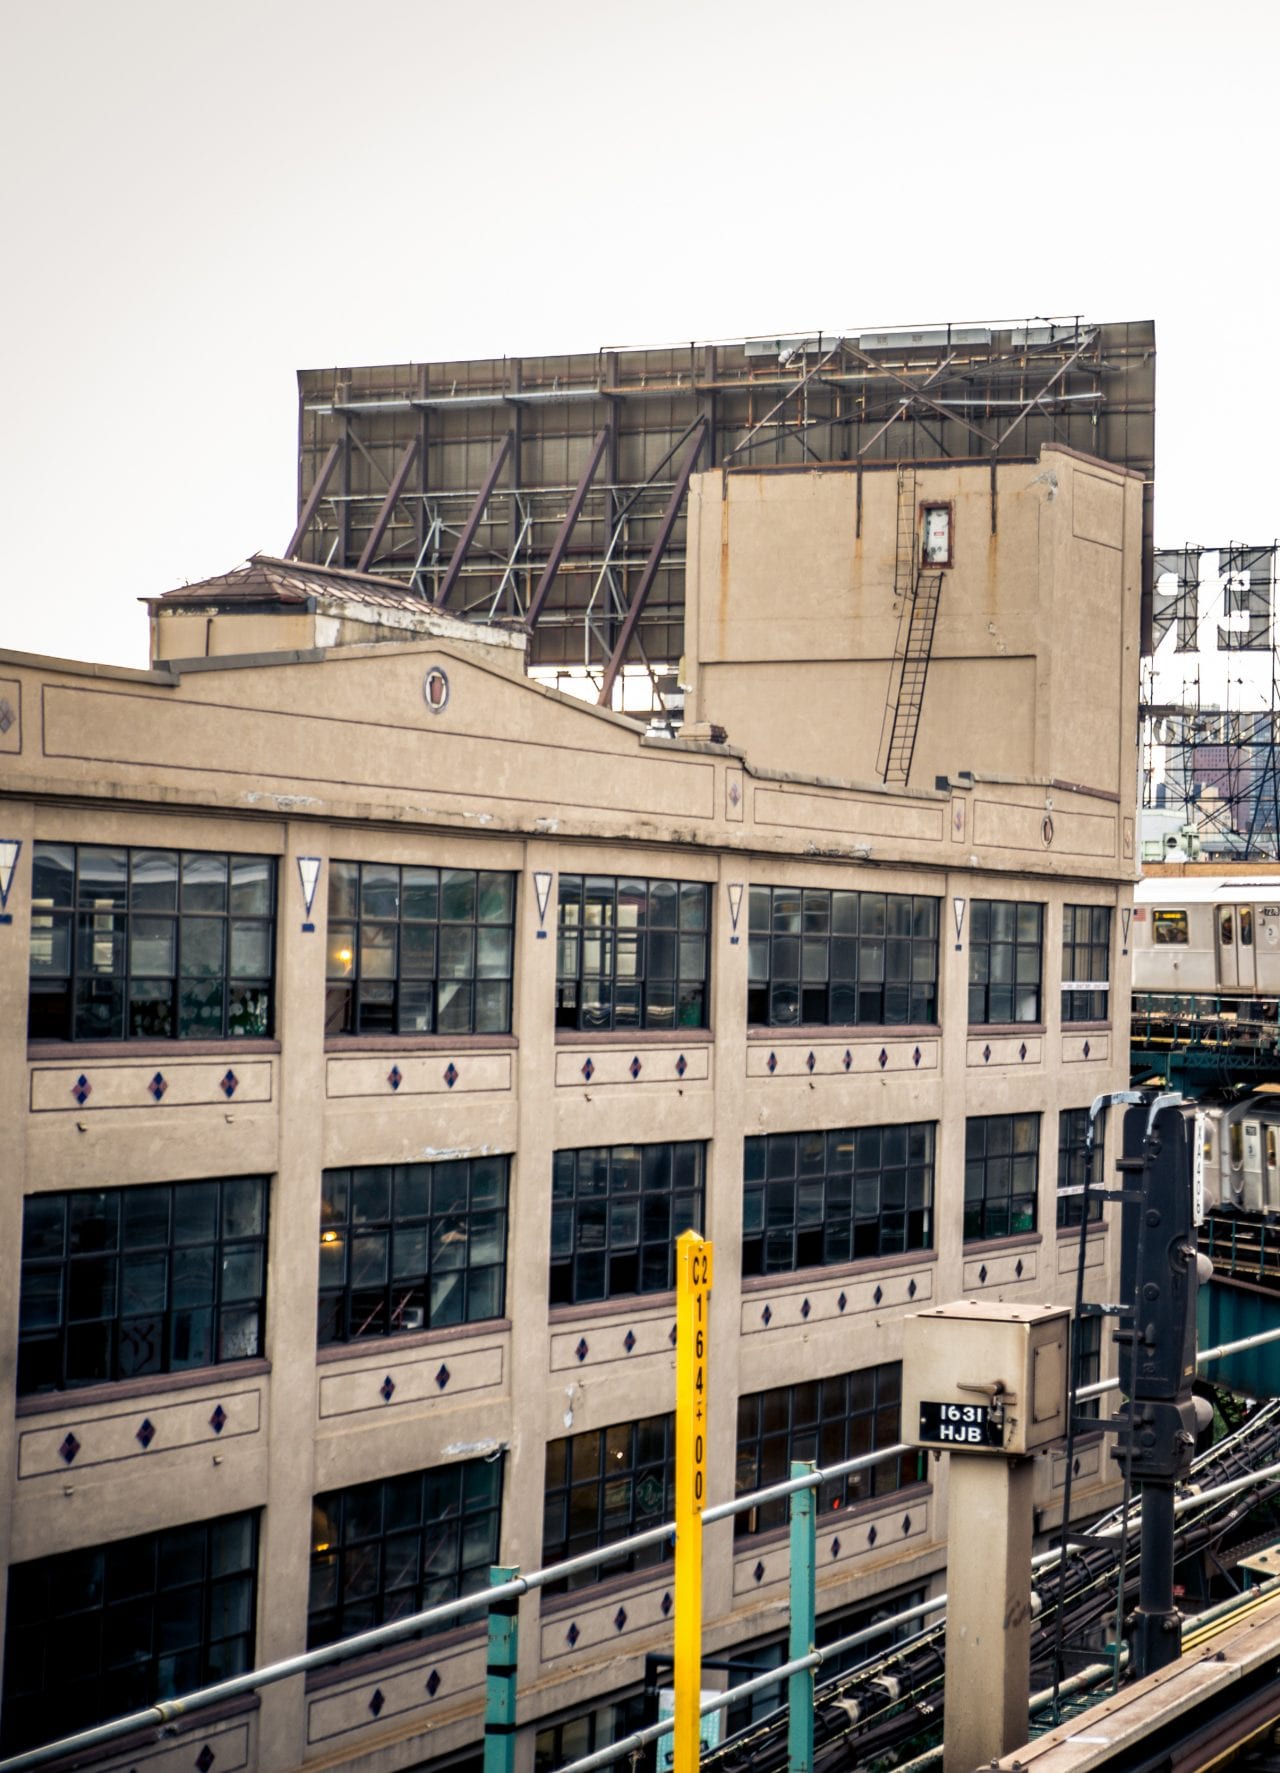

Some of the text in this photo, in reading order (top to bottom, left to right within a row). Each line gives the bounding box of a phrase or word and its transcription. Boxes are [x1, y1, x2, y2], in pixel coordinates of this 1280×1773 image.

[692, 1255, 708, 1286] C2
[940, 1404, 983, 1423] 1631
[940, 1424, 982, 1443] HJB
